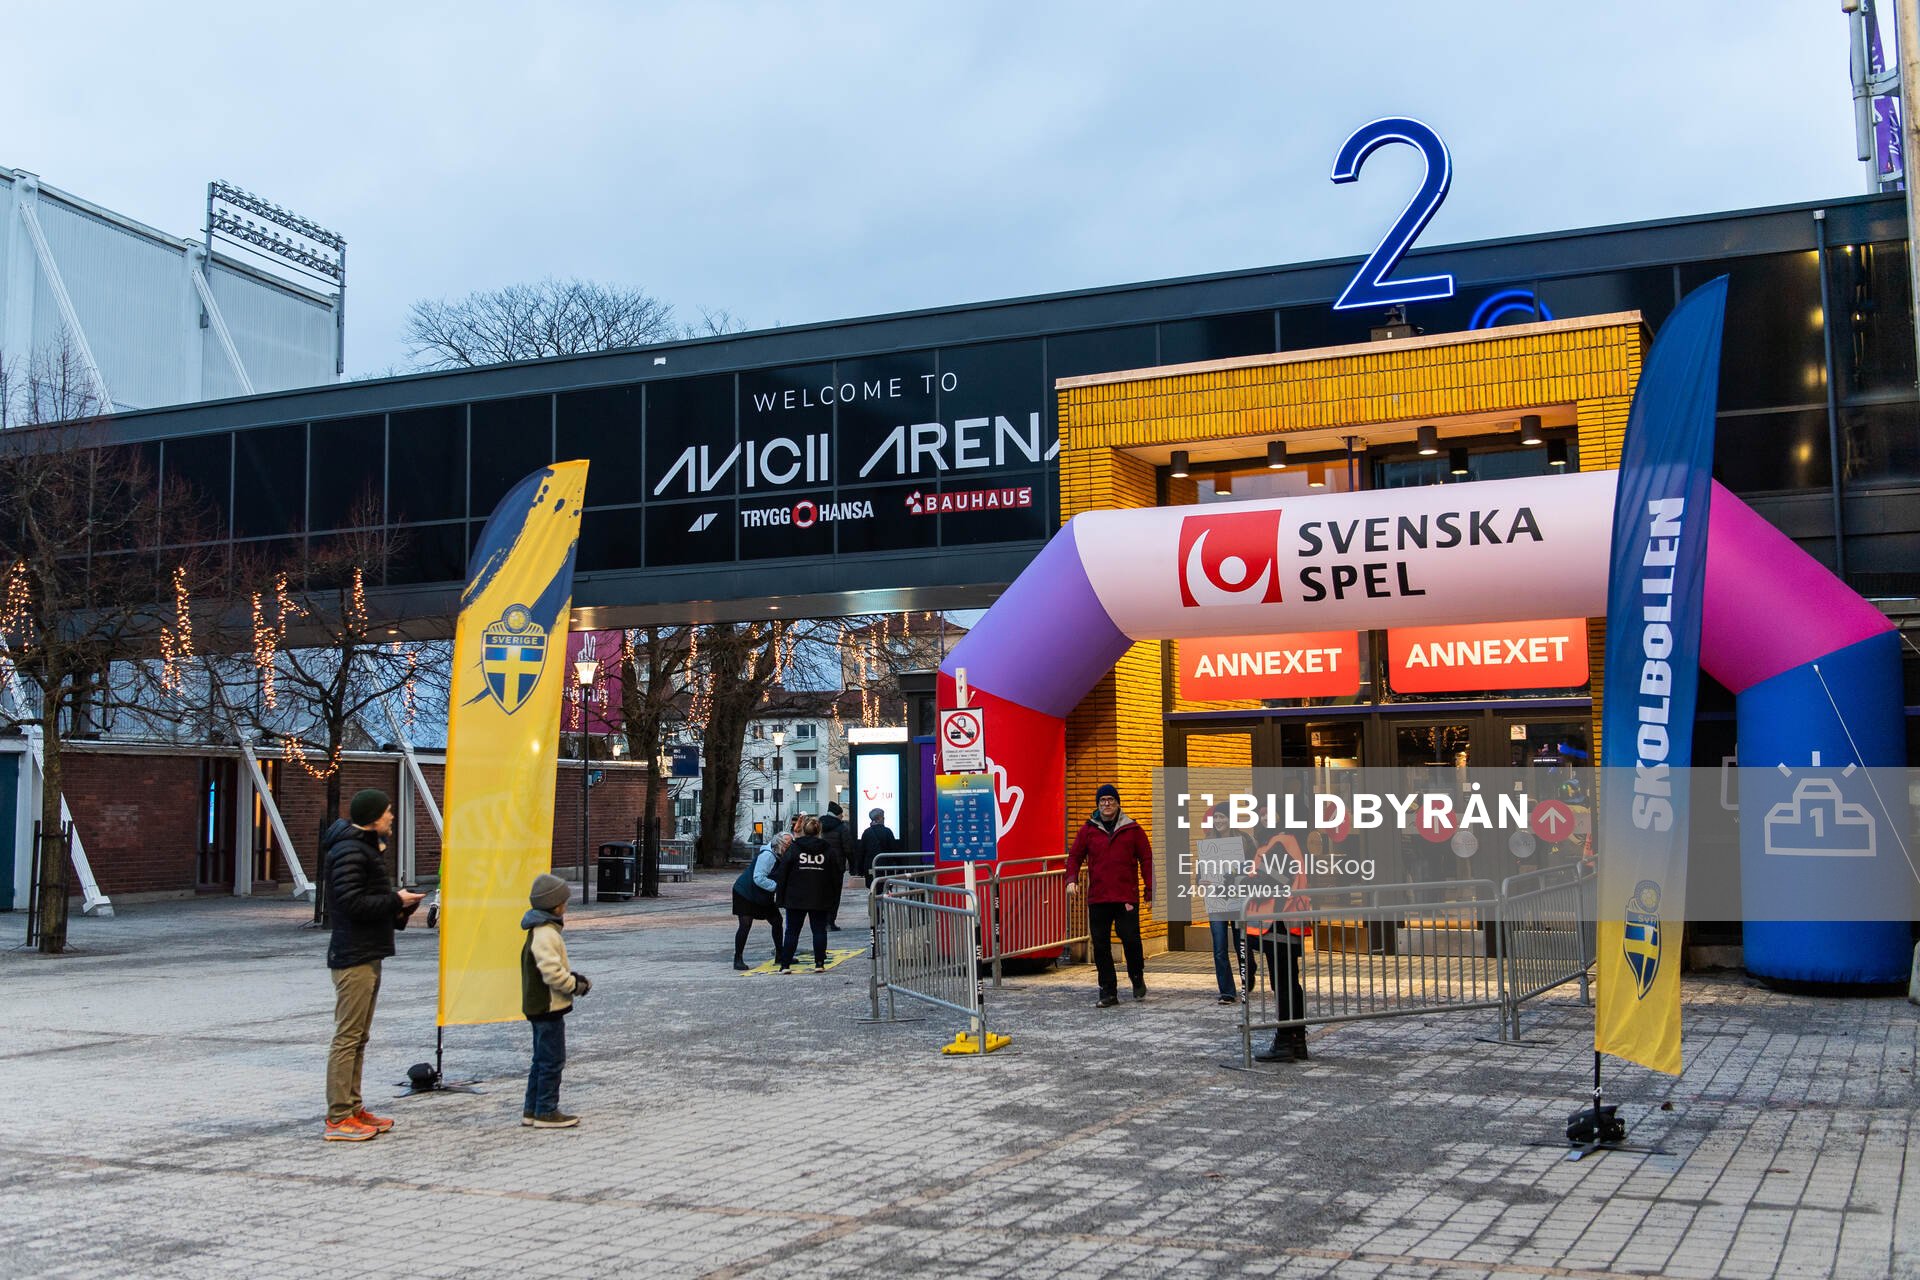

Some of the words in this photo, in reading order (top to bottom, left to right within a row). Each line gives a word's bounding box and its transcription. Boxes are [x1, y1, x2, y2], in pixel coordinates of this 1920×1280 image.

[1330, 115, 1453, 311] 2
[753, 378, 902, 413] WELCOME
[920, 372, 958, 395] TO
[653, 433, 829, 496] AVICII
[741, 507, 791, 528] TRYGG
[819, 501, 875, 521] HANSA
[926, 488, 1030, 511] BAUHAUS
[1298, 507, 1543, 557] SVENSKA
[1299, 561, 1426, 602] SPEL
[491, 636, 539, 645] SVERIGE
[1405, 636, 1570, 669] ANNEXET
[1194, 647, 1343, 678] ANNEXET
[1632, 497, 1685, 833] SKOLBOLLEN
[1809, 807, 1824, 838] 1
[799, 852, 825, 865] SLO
